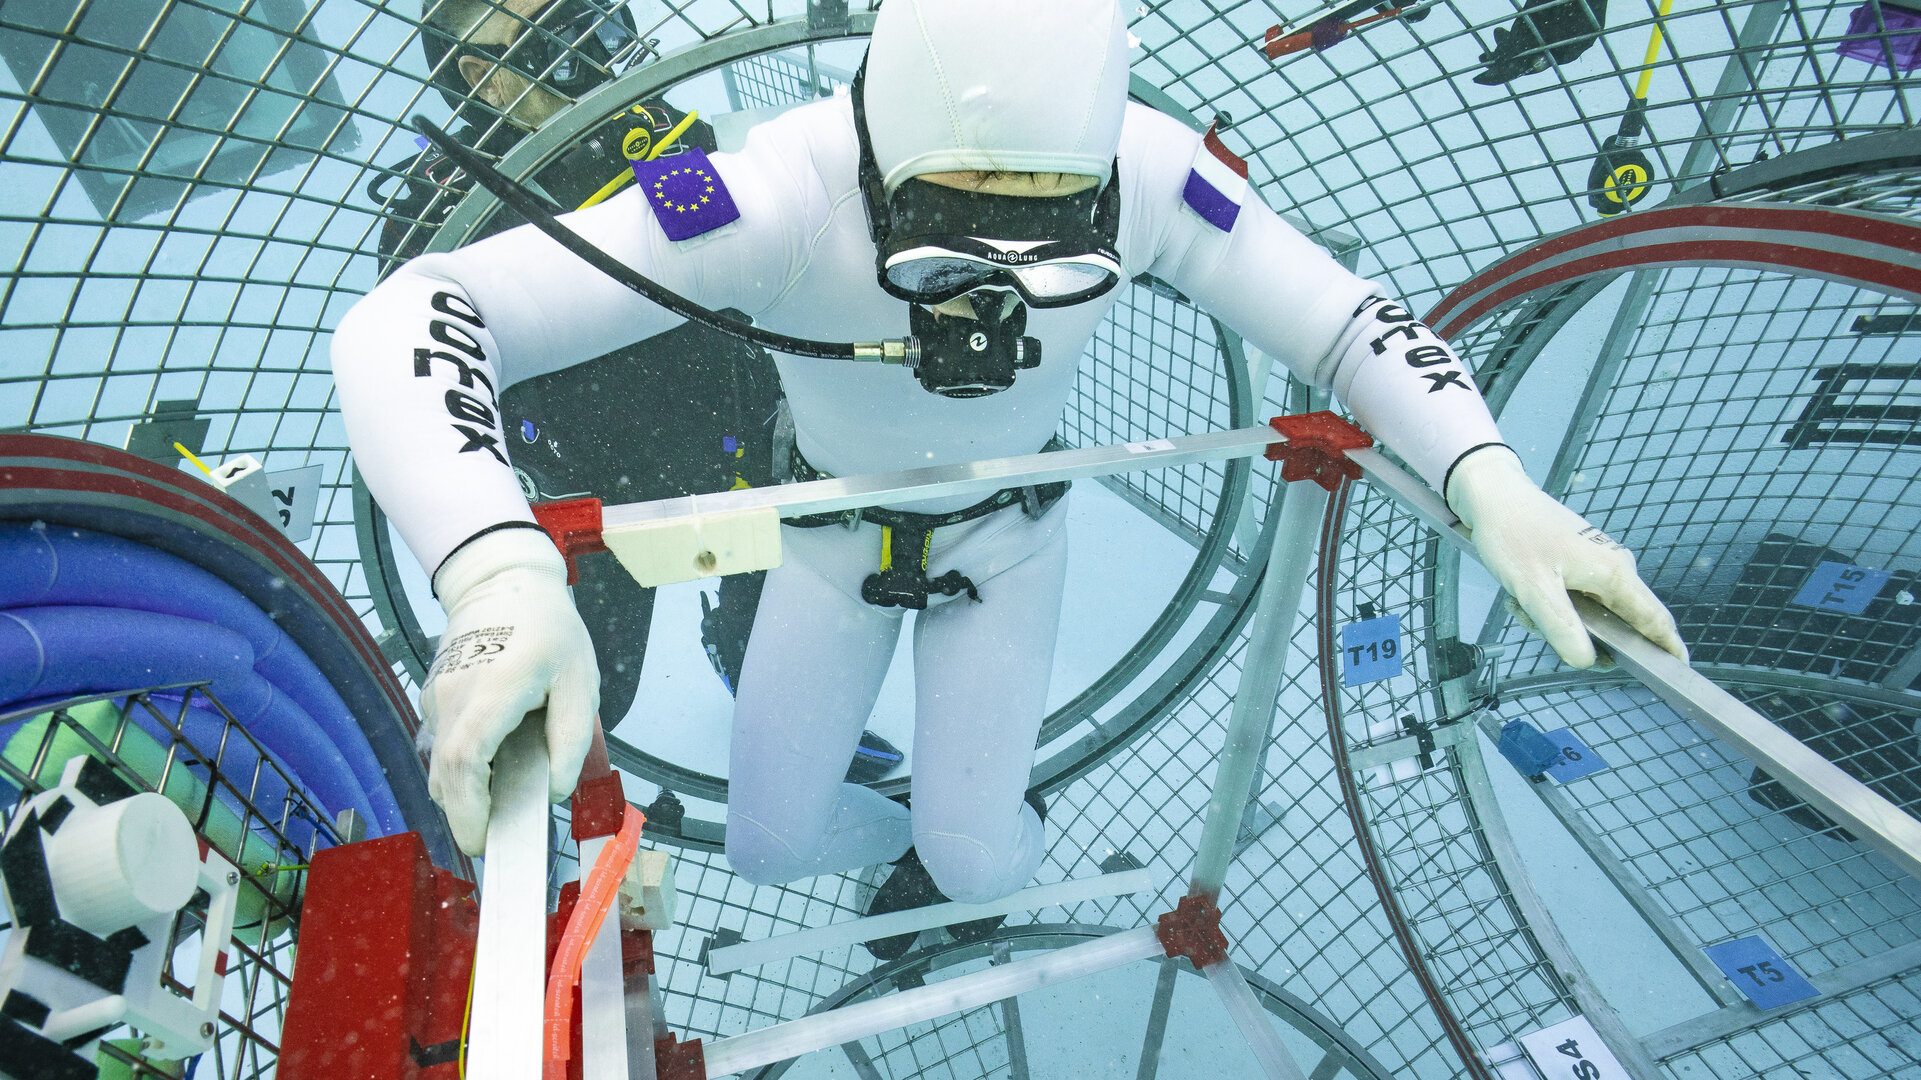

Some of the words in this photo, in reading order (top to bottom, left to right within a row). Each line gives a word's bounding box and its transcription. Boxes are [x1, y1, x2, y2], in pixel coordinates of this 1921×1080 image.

[987, 252, 1007, 261] AQUA
[1018, 254, 1038, 262] LUNG
[1819, 568, 1866, 605] T15
[1346, 638, 1397, 667] T19
[1737, 960, 1785, 987] T5
[1555, 1038, 1600, 1080] S4
